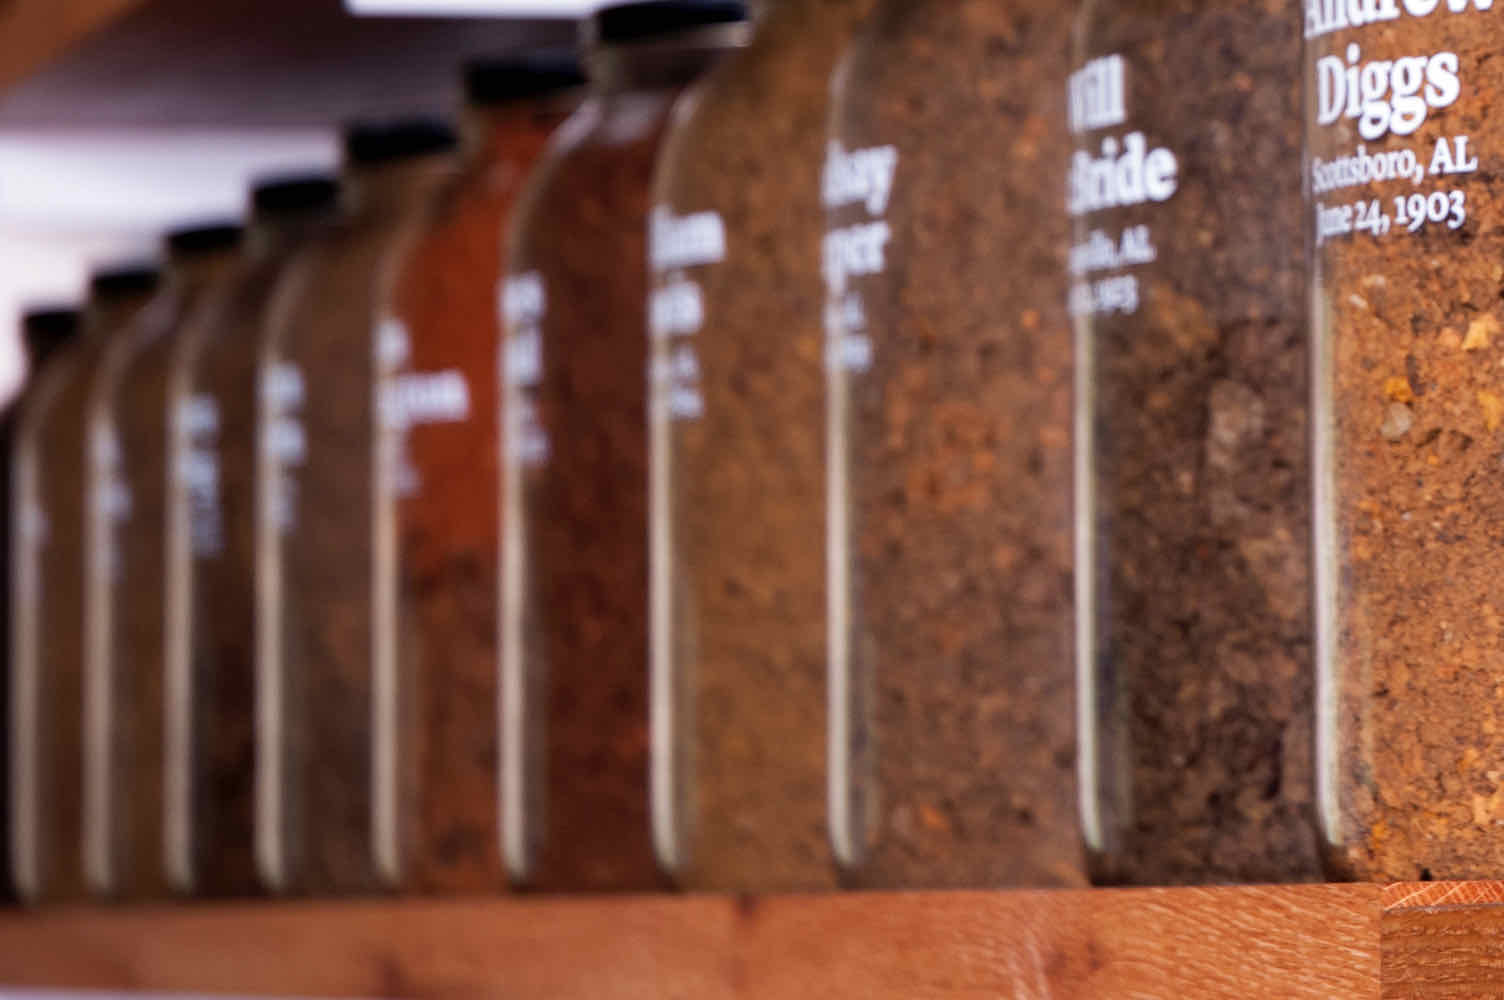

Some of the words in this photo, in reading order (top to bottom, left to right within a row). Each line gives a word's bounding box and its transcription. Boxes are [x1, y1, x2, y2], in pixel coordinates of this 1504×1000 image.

[1316, 43, 1461, 140] Diggs
[1428, 135, 1479, 175] AL
[1354, 199, 1391, 237] 24,
[1393, 189, 1467, 233] 1903
